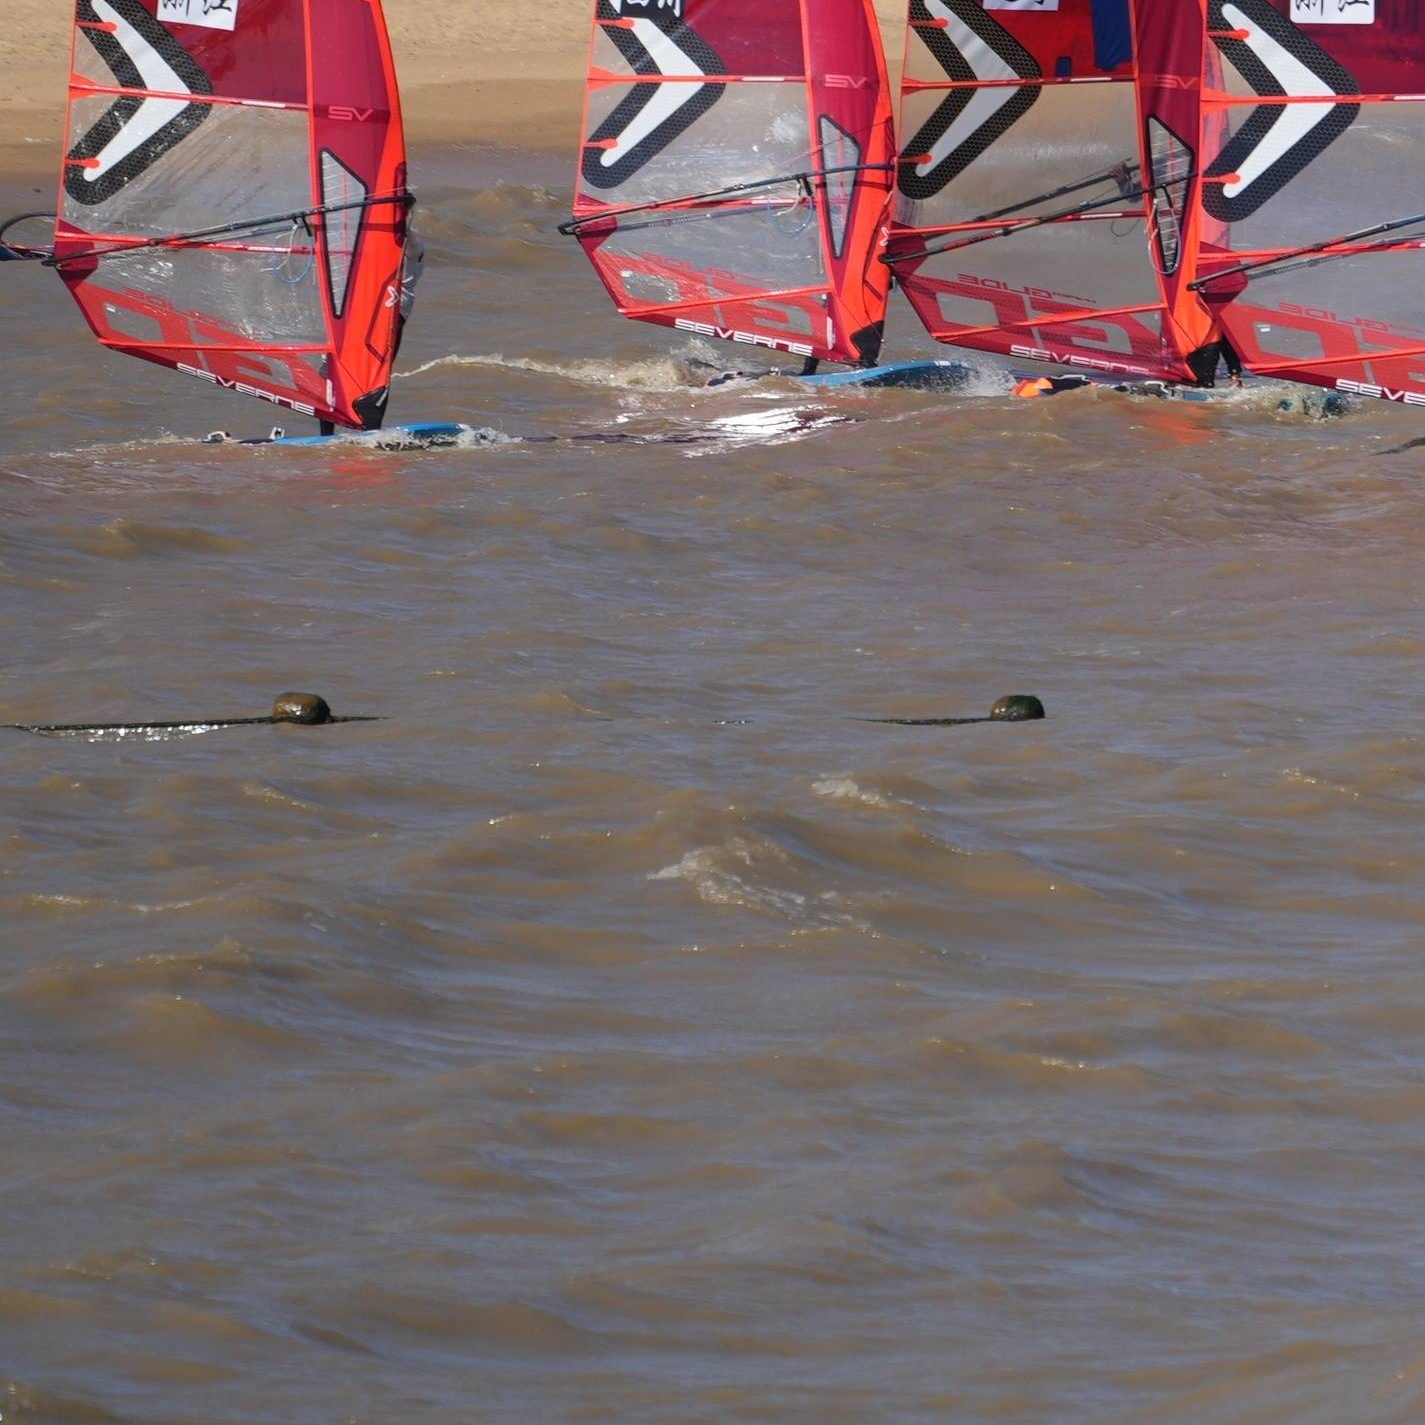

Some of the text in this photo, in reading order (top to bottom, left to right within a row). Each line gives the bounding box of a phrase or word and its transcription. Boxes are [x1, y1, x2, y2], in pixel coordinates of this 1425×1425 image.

[825, 74, 867, 89] SV
[328, 106, 373, 121] SV
[674, 317, 813, 357] SEVERNE
[176, 362, 315, 416] SEVERNE
